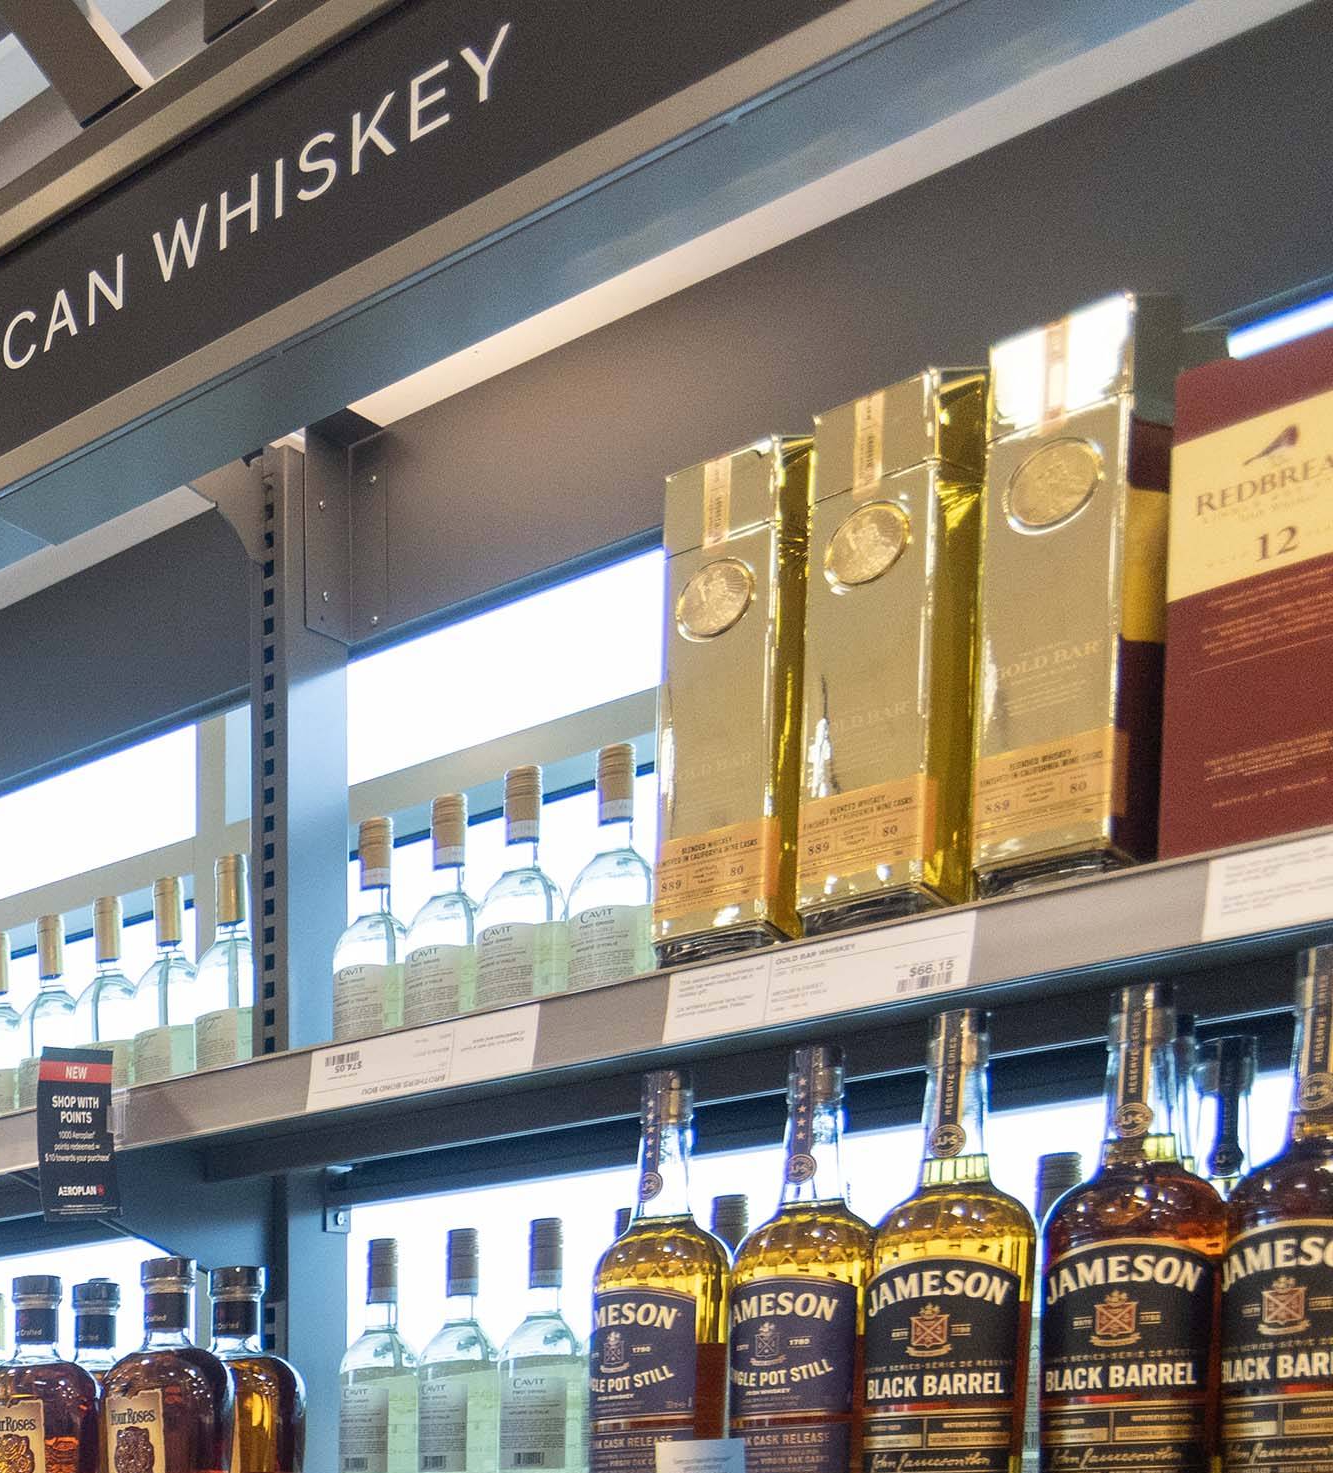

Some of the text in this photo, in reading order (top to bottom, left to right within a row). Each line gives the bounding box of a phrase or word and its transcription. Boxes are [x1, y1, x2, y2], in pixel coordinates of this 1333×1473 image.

[152, 22, 511, 282] WHISKEY
[1256, 525, 1299, 562] 12
[1070, 781, 1087, 794] 80
[882, 824, 898, 836] 80
[909, 958, 955, 979] $66.15
[65, 1066, 88, 1080] NEW
[334, 1061, 363, 1073] $74.05
[52, 1095, 99, 1109] SHOP WITH
[60, 1111, 92, 1124] POINTS
[58, 1185, 97, 1197] AEROPLAN
[1047, 1254, 1203, 1305] JAMESON
[868, 1269, 1012, 1318] JAMESON
[608, 1365, 674, 1392] POT STILL
[759, 1359, 834, 1387] POT STILL
[867, 1370, 1005, 1400] BLACK BARREL
[1045, 1361, 1197, 1393] BLACK BARREL
